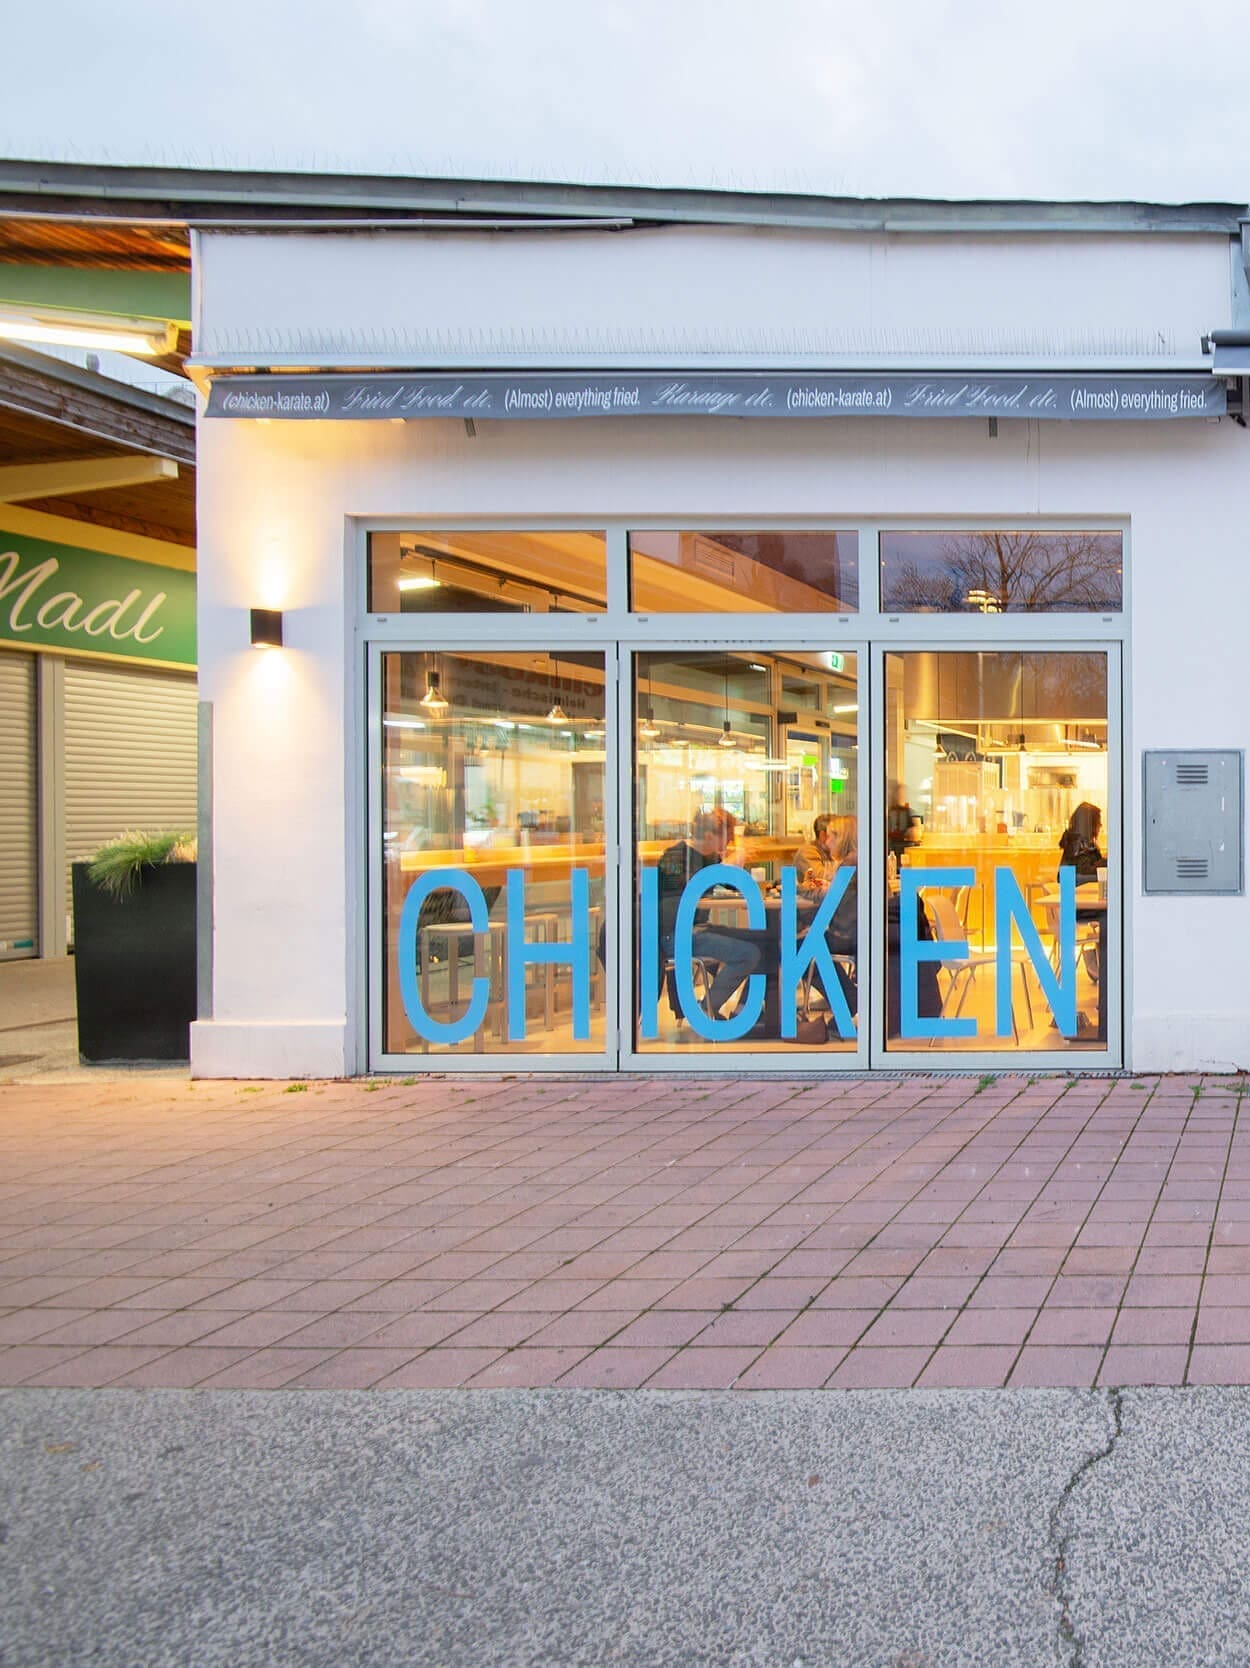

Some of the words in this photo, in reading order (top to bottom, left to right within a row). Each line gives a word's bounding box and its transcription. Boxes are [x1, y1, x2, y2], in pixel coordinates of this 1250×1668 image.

[222, 391, 330, 413] (chicken-karate.at)
[341, 385, 404, 411] Fried
[504, 387, 553, 412] (Almost)
[555, 386, 612, 411] everything
[613, 387, 640, 405] fried.
[786, 387, 892, 409] (chicken-karate.at)
[904, 384, 968, 407] Fried
[1070, 388, 1119, 412] (Almost)
[1121, 389, 1178, 413] everything
[1179, 389, 1207, 409] fried.
[400, 865, 1076, 1042] CHICKEN
